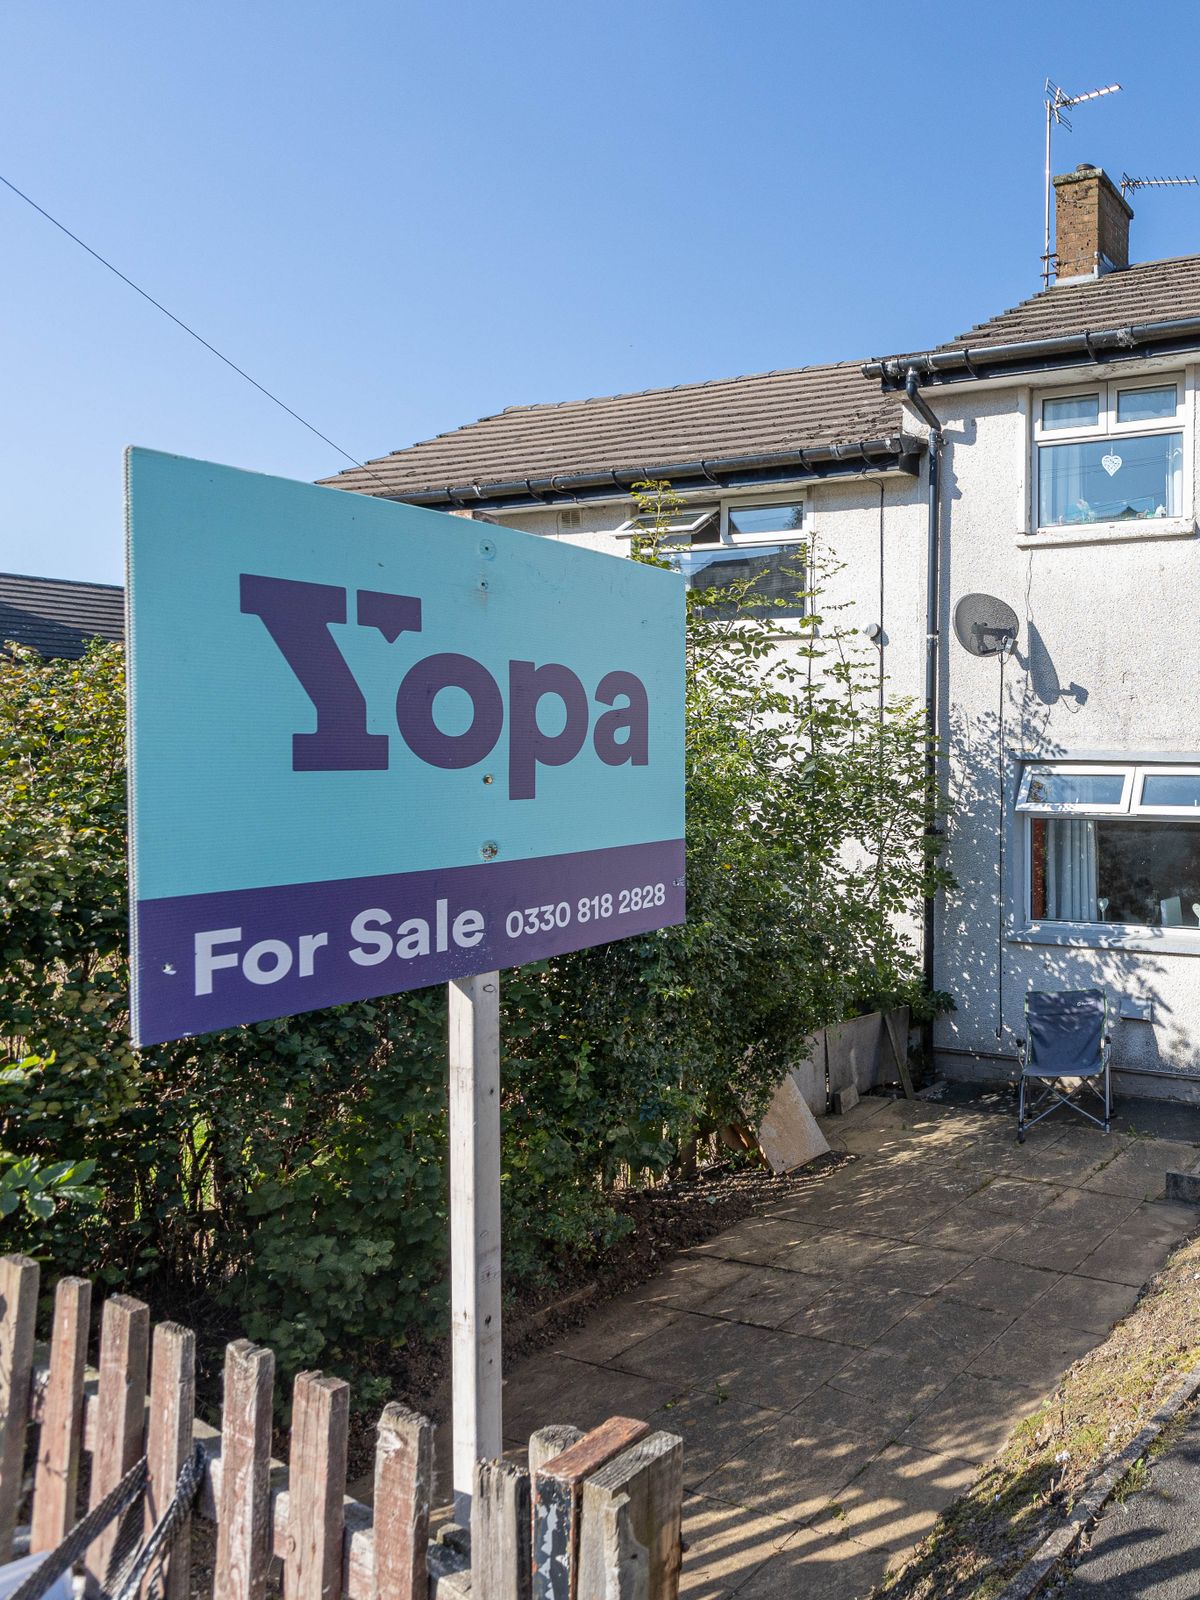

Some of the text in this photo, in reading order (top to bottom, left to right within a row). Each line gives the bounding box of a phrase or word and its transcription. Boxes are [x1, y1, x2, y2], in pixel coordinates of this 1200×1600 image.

[239, 573, 649, 800] Yopa
[194, 898, 485, 996] For Sale
[505, 882, 666, 939] 0330 818 2828
